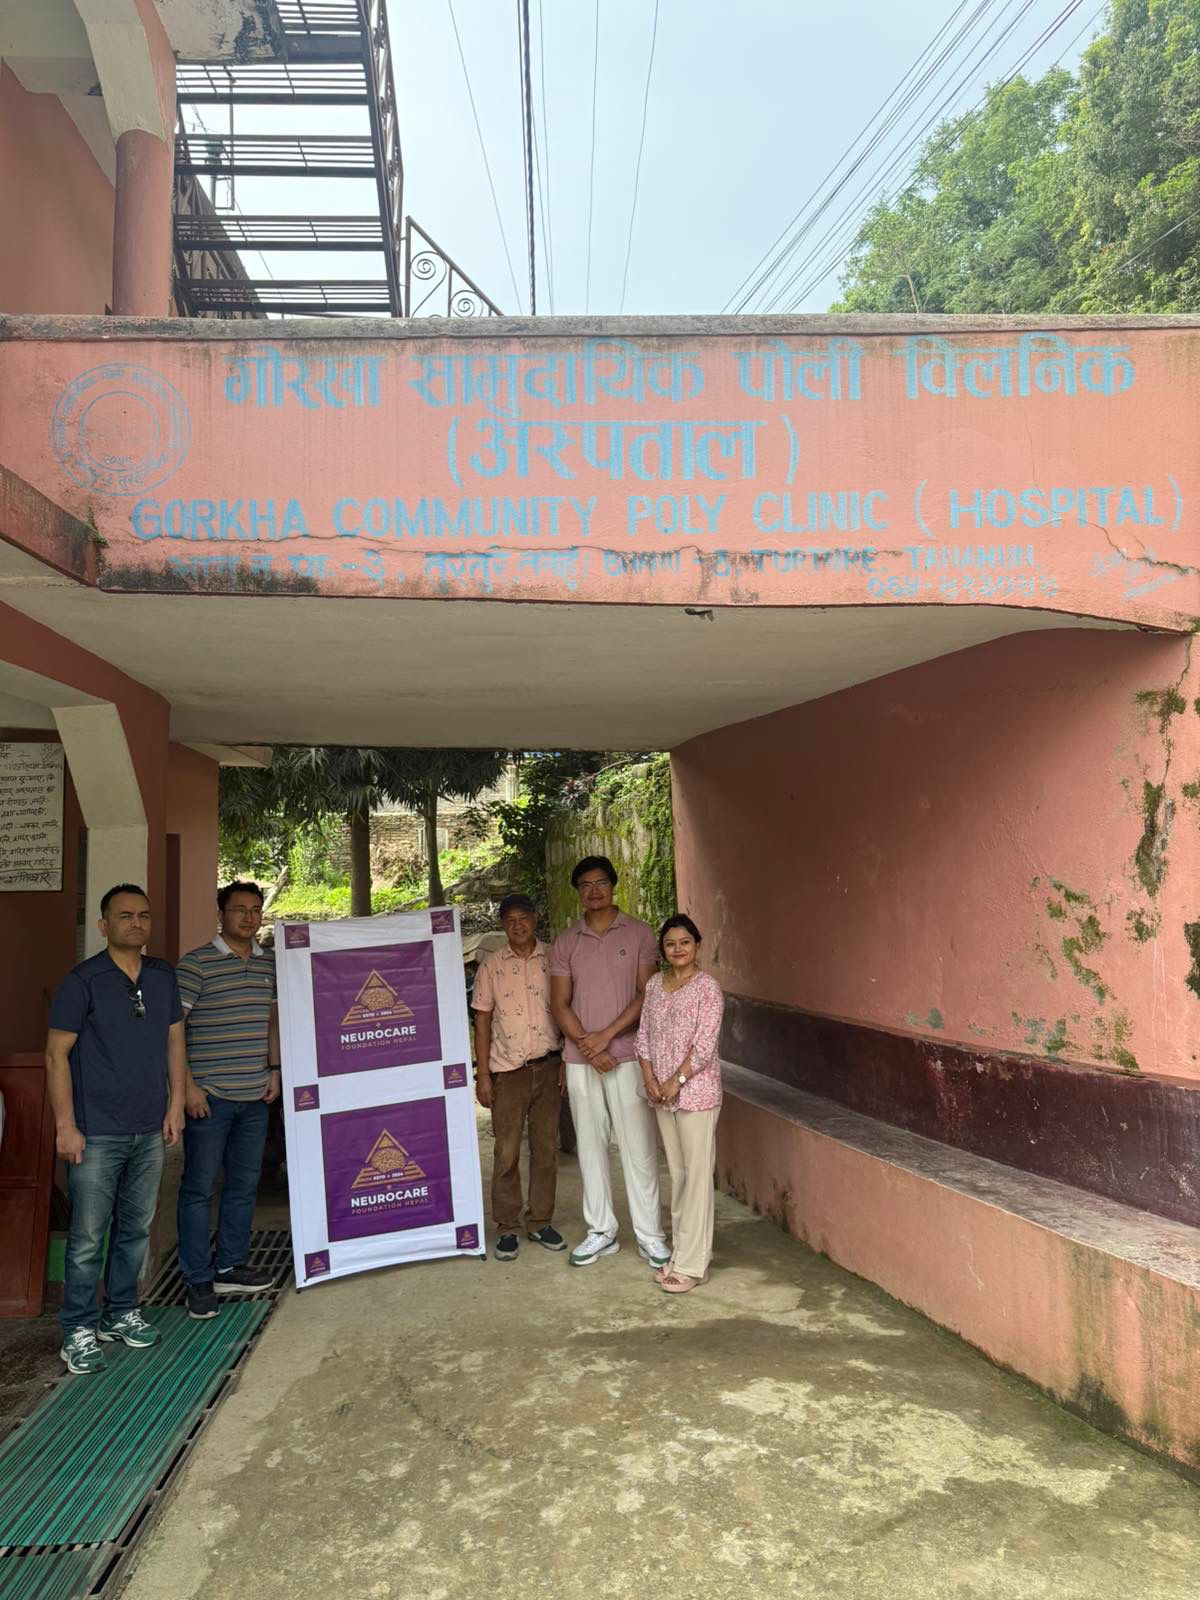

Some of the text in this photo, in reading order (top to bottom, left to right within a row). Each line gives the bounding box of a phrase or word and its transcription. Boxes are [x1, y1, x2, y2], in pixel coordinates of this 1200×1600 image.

[224, 345, 385, 410] गोरखा
[408, 336, 705, 419] सामुदायिक
[731, 337, 864, 401] पोली
[131, 499, 309, 540] GORKHA
[332, 494, 598, 540] COMMUNITY
[627, 493, 728, 536] POLY
[752, 489, 889, 534] CLINIC
[340, 1025, 417, 1043] NEUROCARE
[341, 1035, 417, 1050] FOUNDATION NEPAL
[351, 1186, 429, 1208] NEUROCARE
[351, 1198, 429, 1214] FOUNDATION NEPAL
